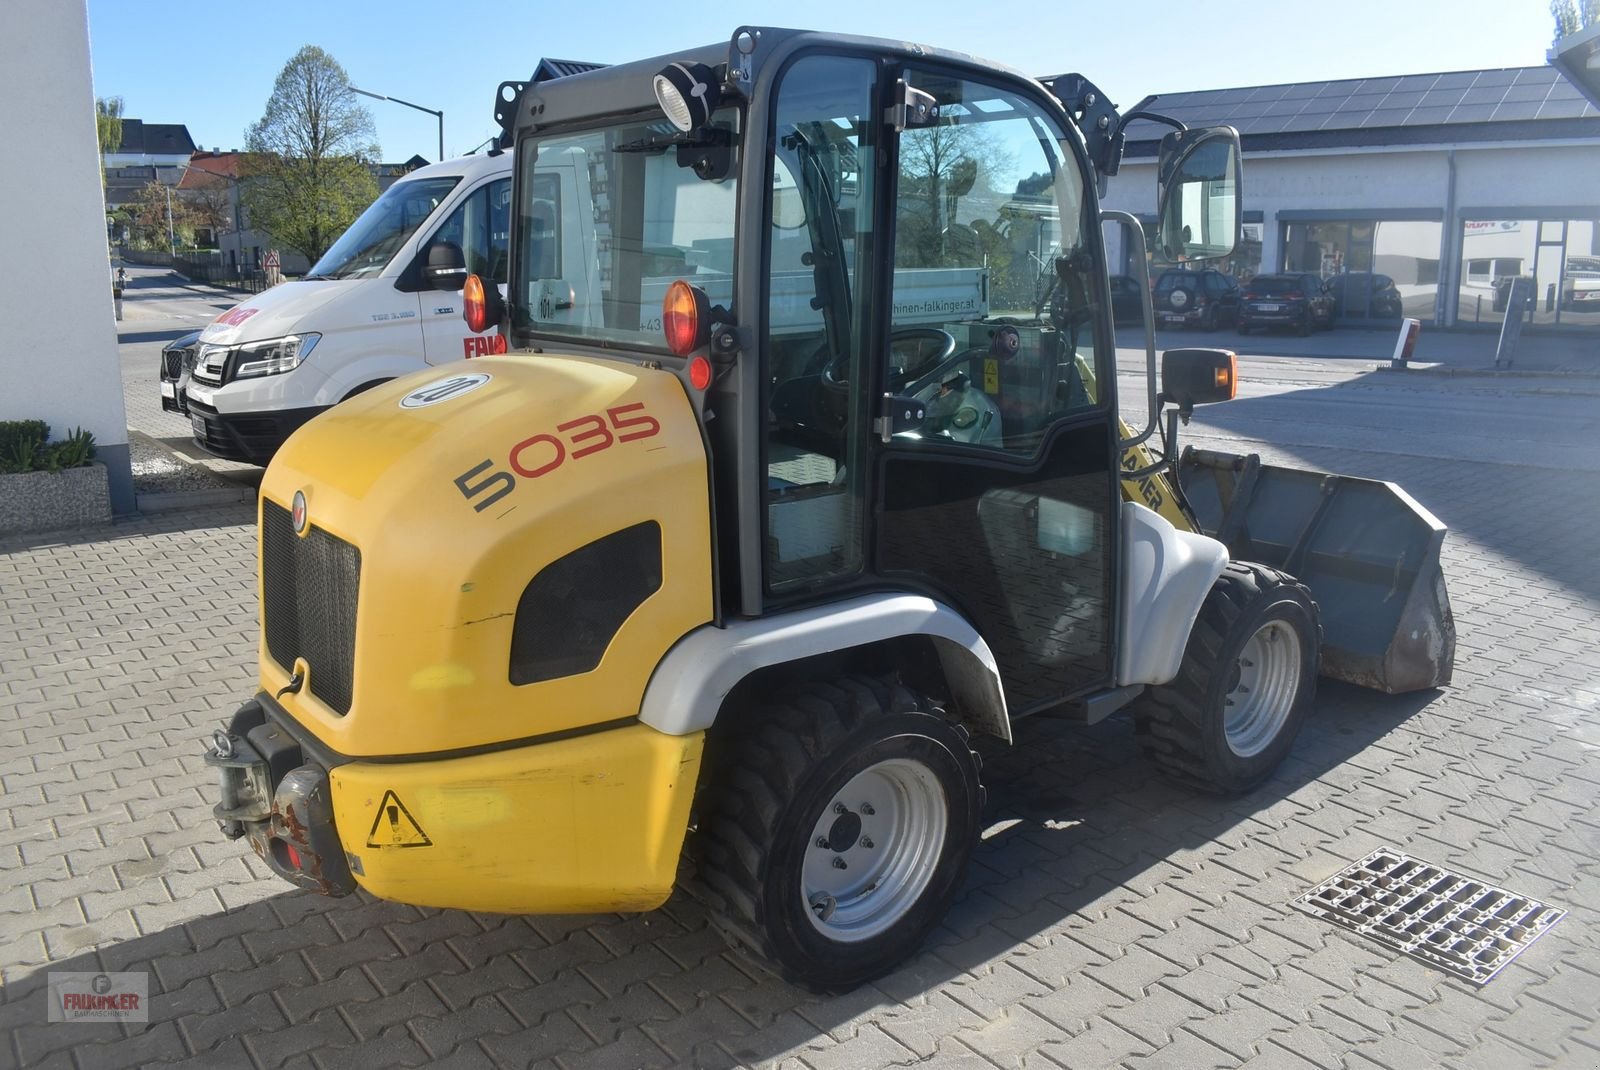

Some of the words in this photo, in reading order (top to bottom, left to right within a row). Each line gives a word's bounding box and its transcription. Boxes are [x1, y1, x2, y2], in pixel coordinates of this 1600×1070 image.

[463, 335, 499, 359] FAL
[409, 377, 480, 402] 20
[453, 402, 661, 513] 5035
